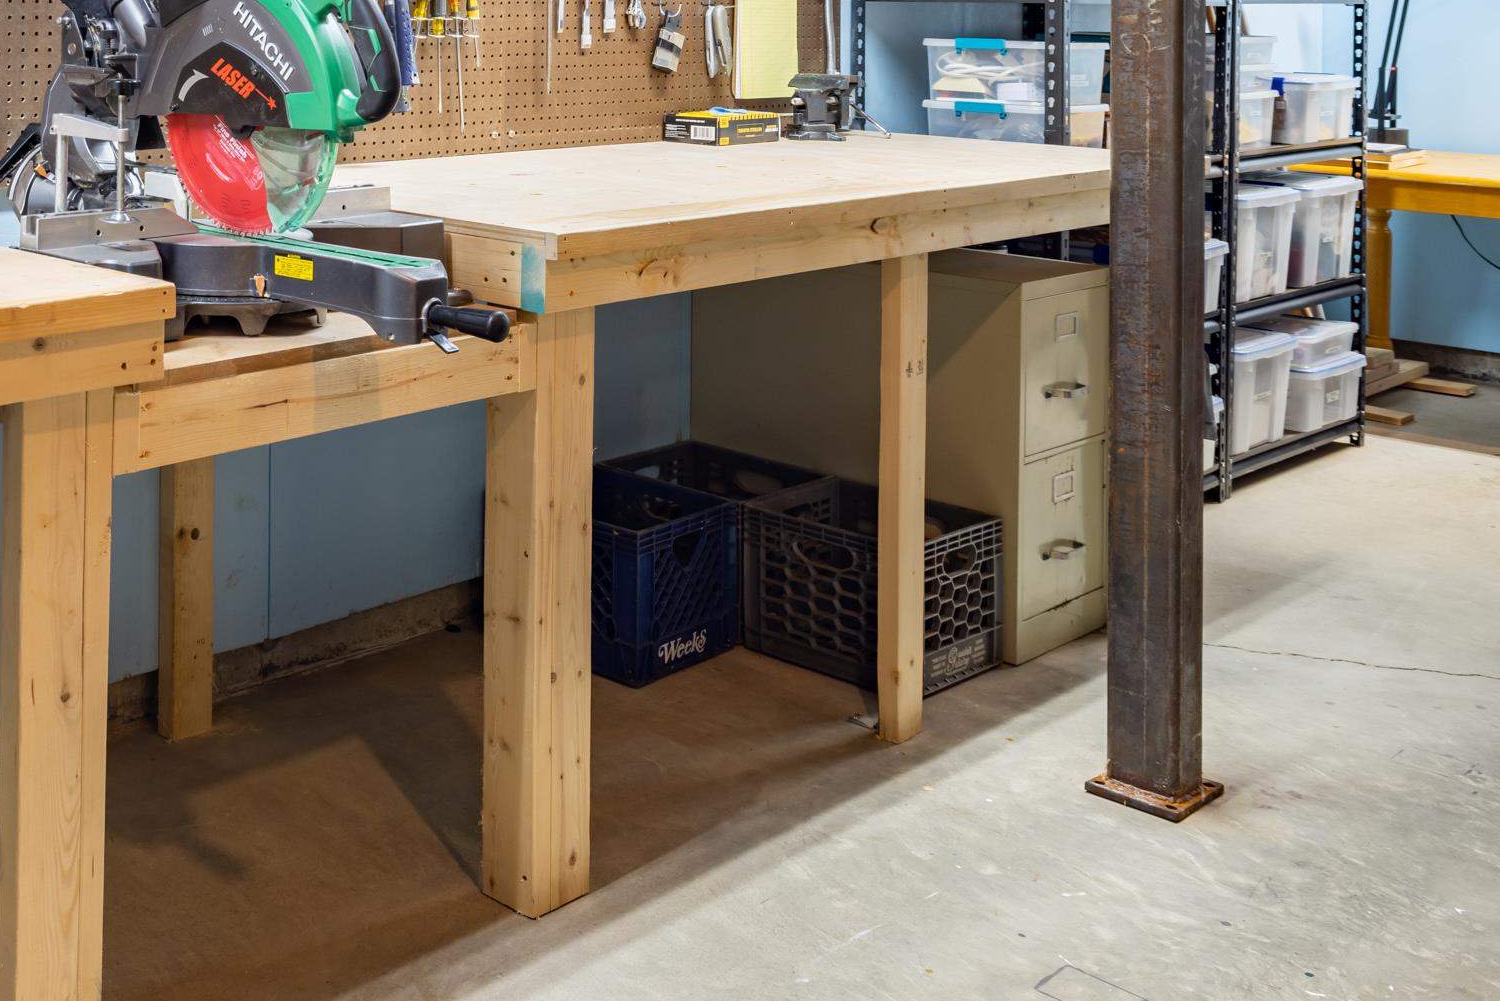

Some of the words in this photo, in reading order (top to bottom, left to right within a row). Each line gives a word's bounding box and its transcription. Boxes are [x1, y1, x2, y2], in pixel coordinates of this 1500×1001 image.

[232, 1, 295, 81] HITACHI
[210, 57, 256, 100] LASER
[229, 135, 249, 160] Finish
[658, 629, 707, 664] Weeks
